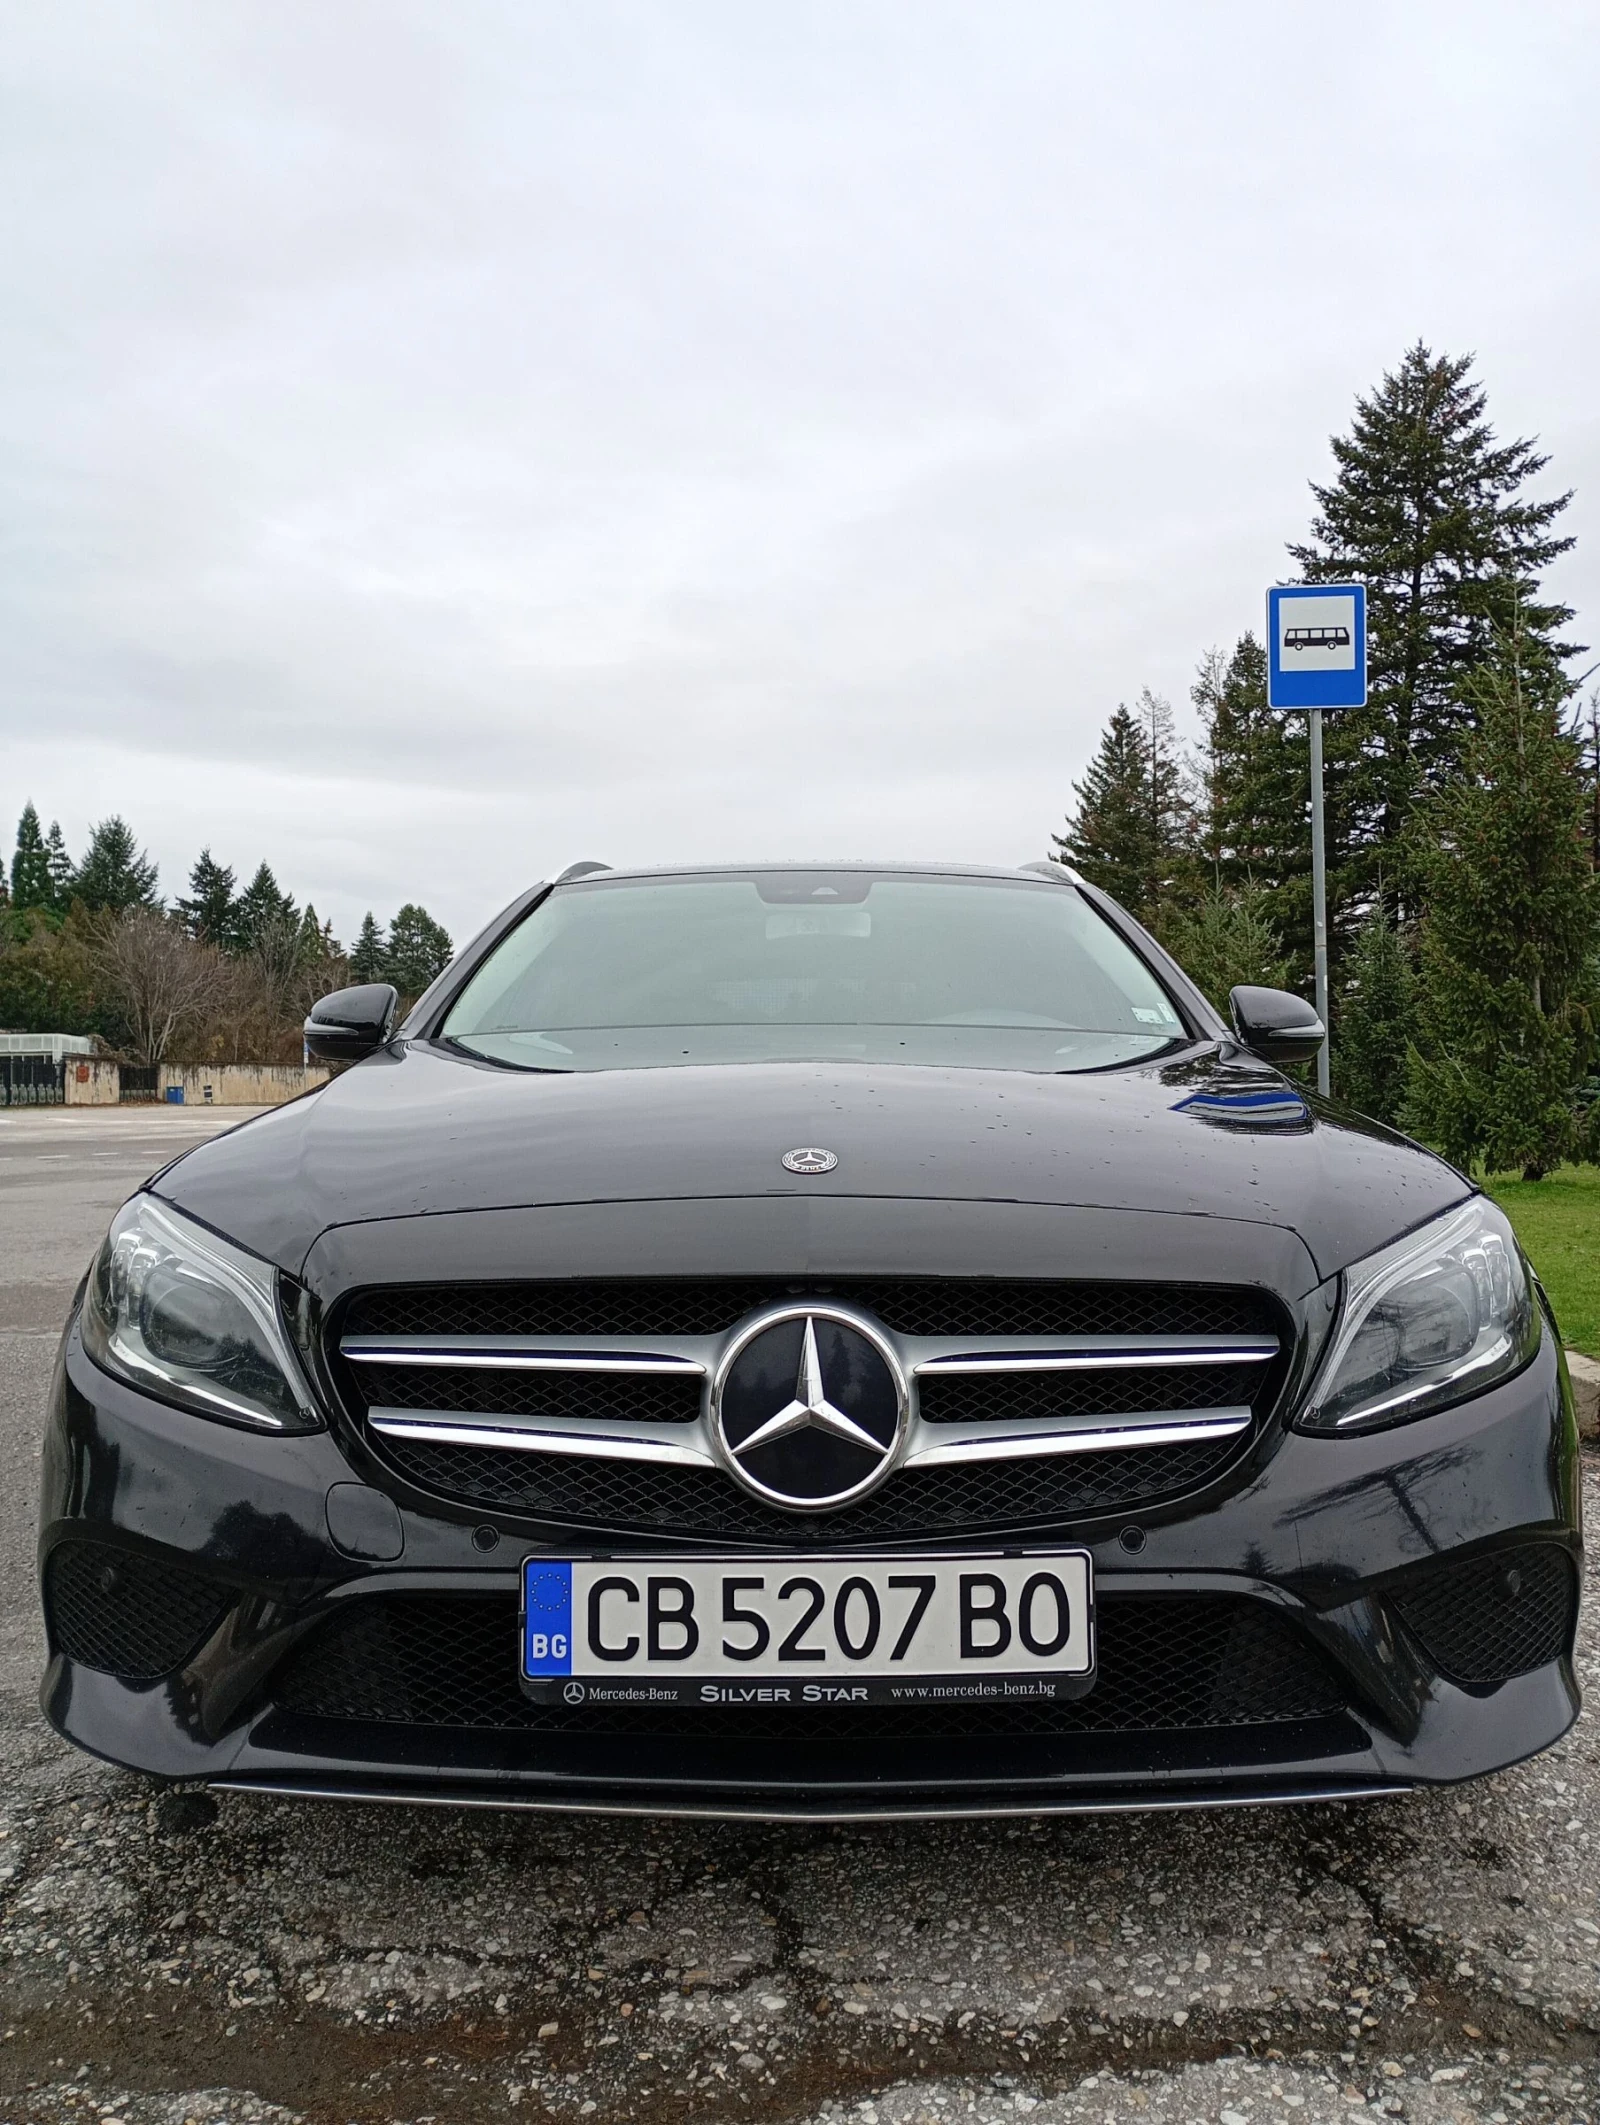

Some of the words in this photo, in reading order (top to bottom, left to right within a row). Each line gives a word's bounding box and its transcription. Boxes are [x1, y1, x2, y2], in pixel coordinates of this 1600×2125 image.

[587, 1576, 700, 1662] CB
[722, 1575, 936, 1662] 5207
[532, 1633, 567, 1659] BG
[588, 1687, 678, 1700] Mercedes-Benz
[699, 1684, 791, 1703] SILVER
[802, 1684, 869, 1702] STAR
[890, 1680, 1057, 1699] www.mercedes-benz.bg
